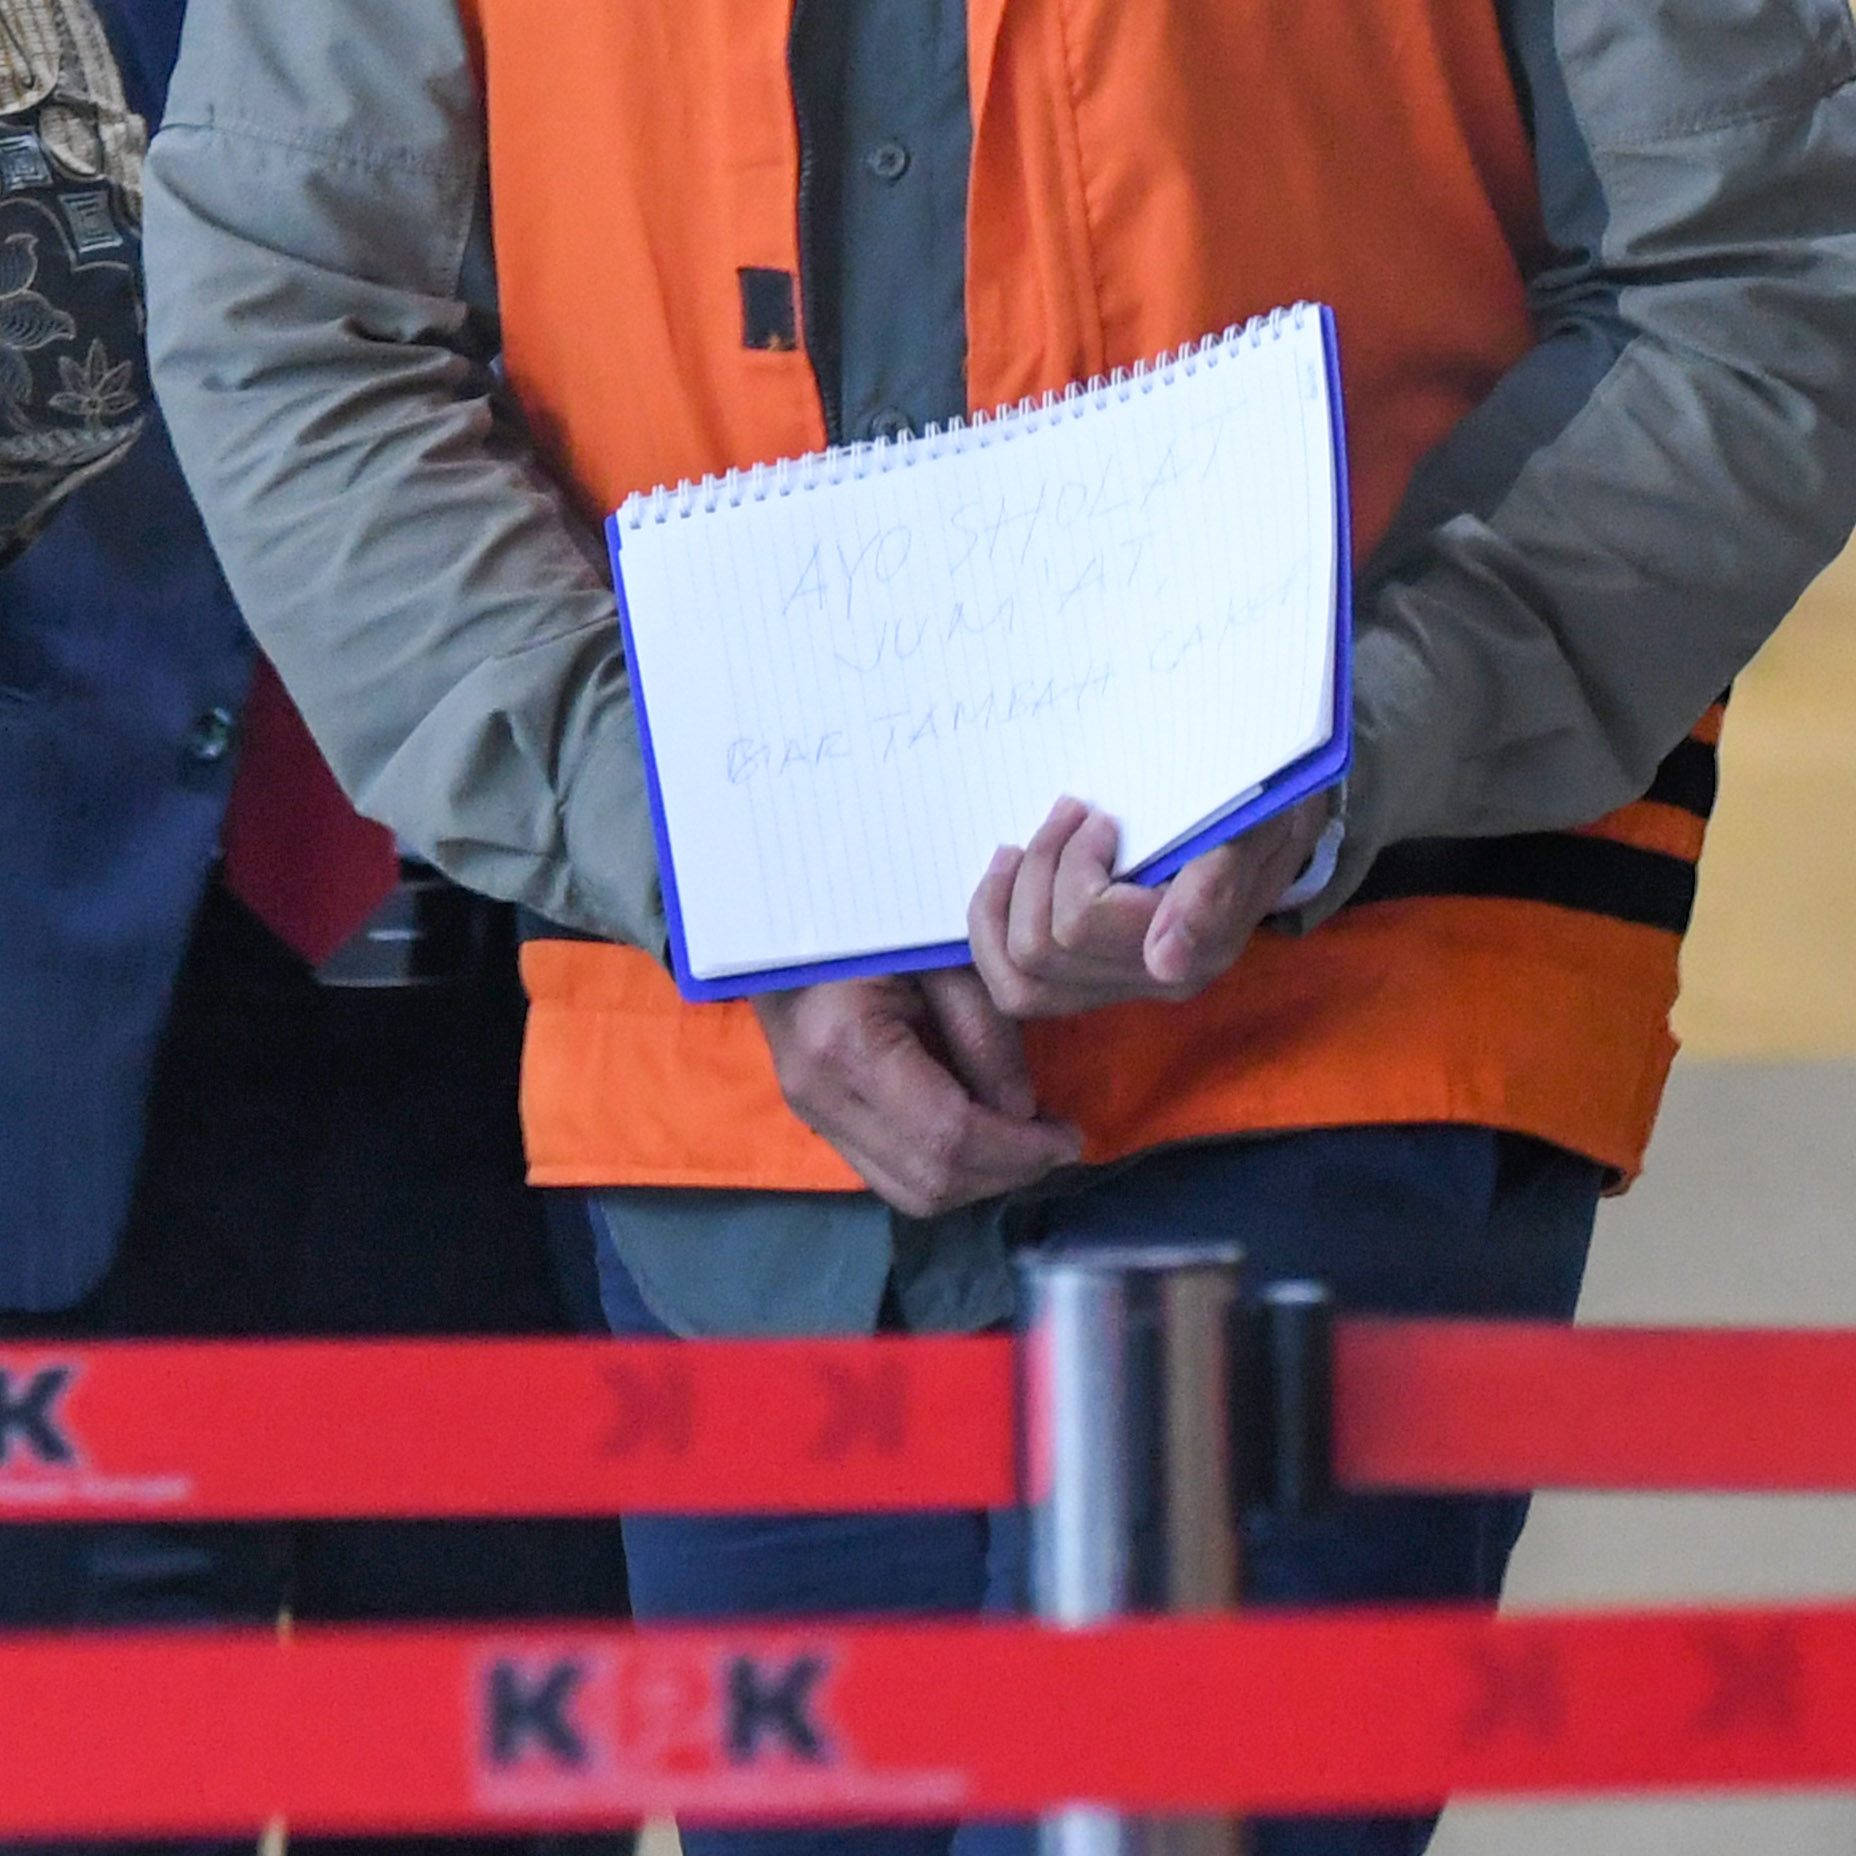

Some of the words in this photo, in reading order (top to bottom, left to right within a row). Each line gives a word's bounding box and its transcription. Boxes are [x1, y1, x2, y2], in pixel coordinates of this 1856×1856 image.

[781, 525, 913, 621] AYO
[949, 400, 1245, 576] SHOLAT
[873, 661, 1118, 763] TAMBAH
[480, 1654, 836, 1770] KPK
